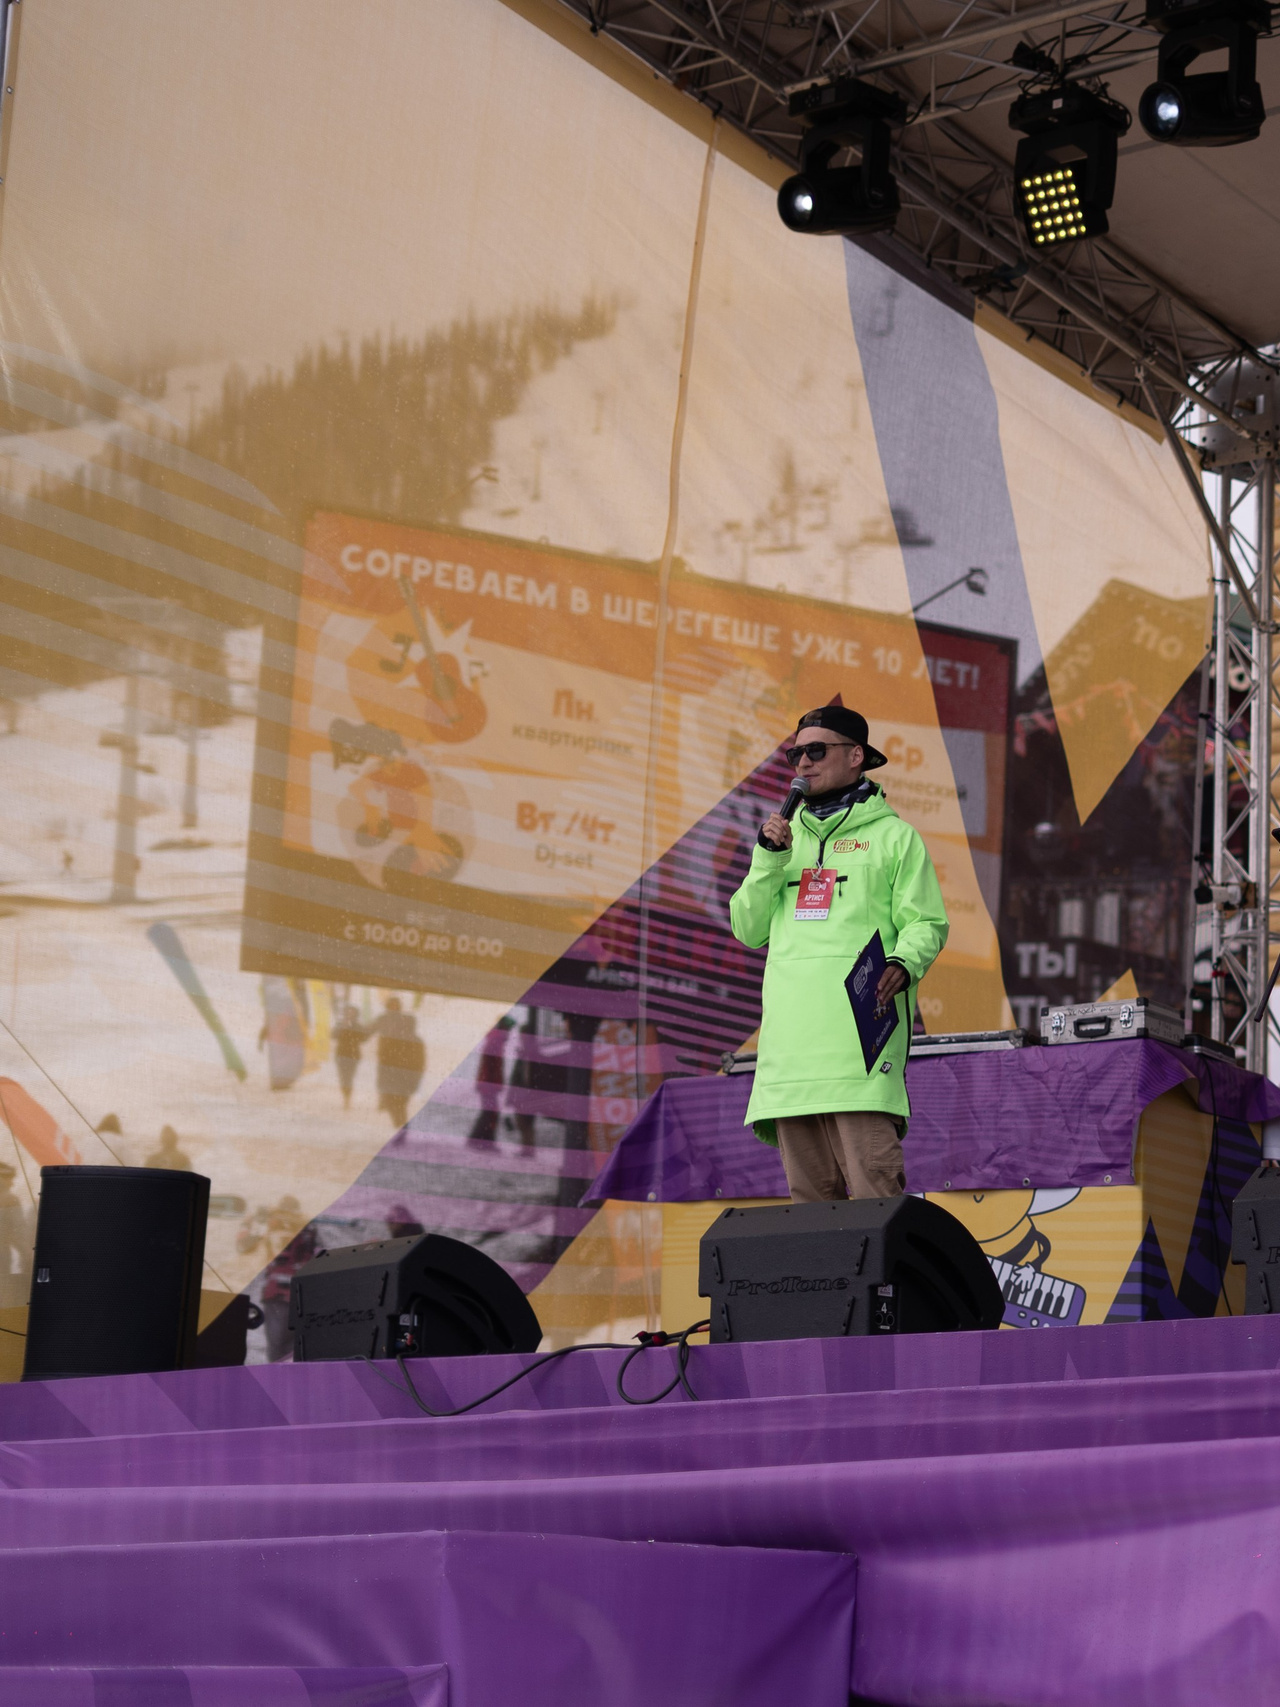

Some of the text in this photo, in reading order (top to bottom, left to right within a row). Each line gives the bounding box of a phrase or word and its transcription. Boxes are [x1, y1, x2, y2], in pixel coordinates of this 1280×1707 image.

[340, 544, 980, 690] СОГРЕВАЕМ В ШЕРЕГЕШЕ УЖЕ 10 ЛЕТ!
[362, 922, 420, 947] 10:00
[423, 934, 451, 952] до
[728, 1276, 850, 1296] ProTone
[880, 1302, 888, 1314] 4
